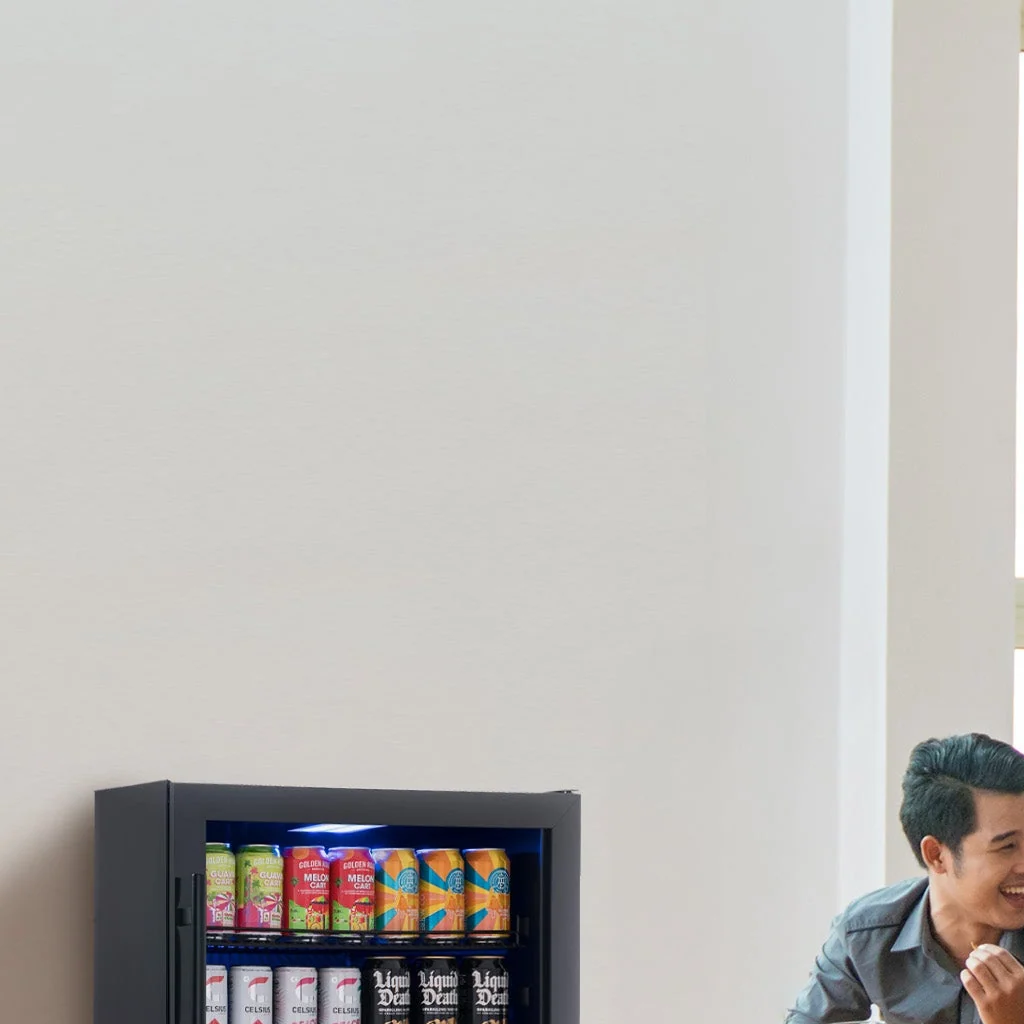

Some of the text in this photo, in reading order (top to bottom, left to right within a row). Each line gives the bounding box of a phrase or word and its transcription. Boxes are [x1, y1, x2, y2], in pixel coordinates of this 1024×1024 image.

[299, 860, 321, 870] GOLDEN
[343, 861, 366, 870] GOLDEN
[210, 870, 235, 878] GUAV
[347, 874, 375, 883] MELON
[418, 970, 459, 993] Liquid
[420, 988, 459, 1006] Death
[292, 1006, 317, 1014] CELSIU
[332, 1006, 360, 1014] CELSIUS
